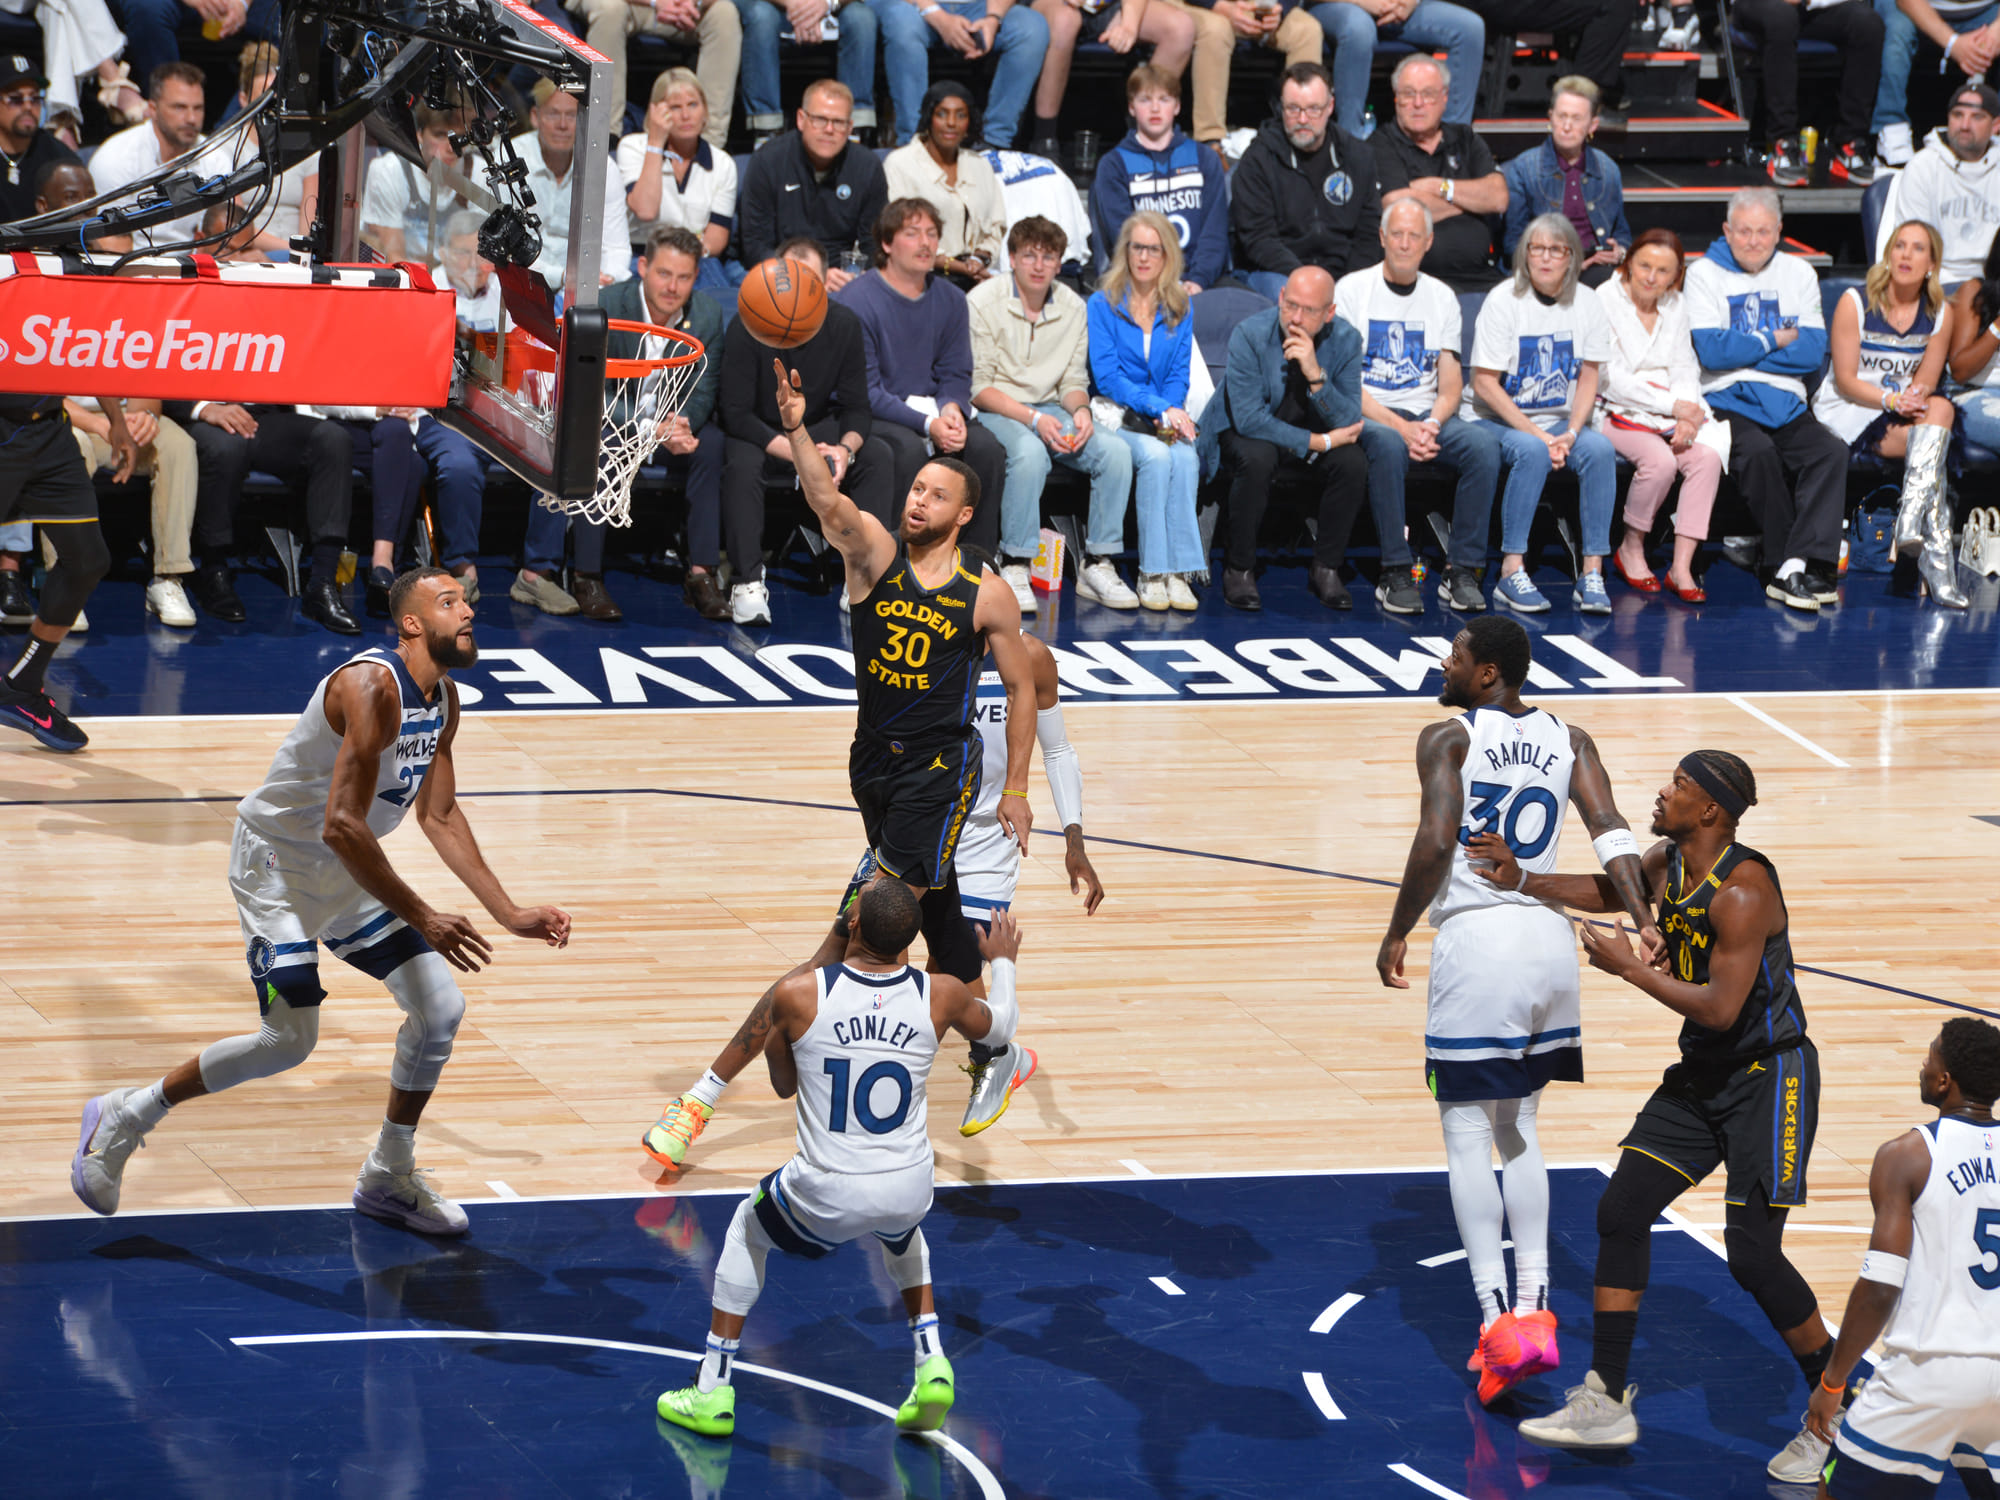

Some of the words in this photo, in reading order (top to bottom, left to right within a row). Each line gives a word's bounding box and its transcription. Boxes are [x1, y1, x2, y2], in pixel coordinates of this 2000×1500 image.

[1133, 189, 1202, 213] MINNESOT
[1861, 355, 1920, 374] WOLVE
[875, 600, 958, 641] GOLDEN
[936, 594, 966, 608] Rakuten
[880, 622, 931, 668] 30
[867, 658, 930, 690] STATE
[395, 737, 437, 760] WOLVE
[1484, 741, 1559, 776] RANDLE
[377, 764, 430, 808] 27
[1456, 780, 1559, 860] 30
[833, 1015, 920, 1049] CONLEY
[824, 1057, 913, 1135] 10
[1782, 1077, 1799, 1183] WARRIORS
[1946, 1157, 2000, 1196] EDWA
[1968, 1207, 2000, 1291] 5
